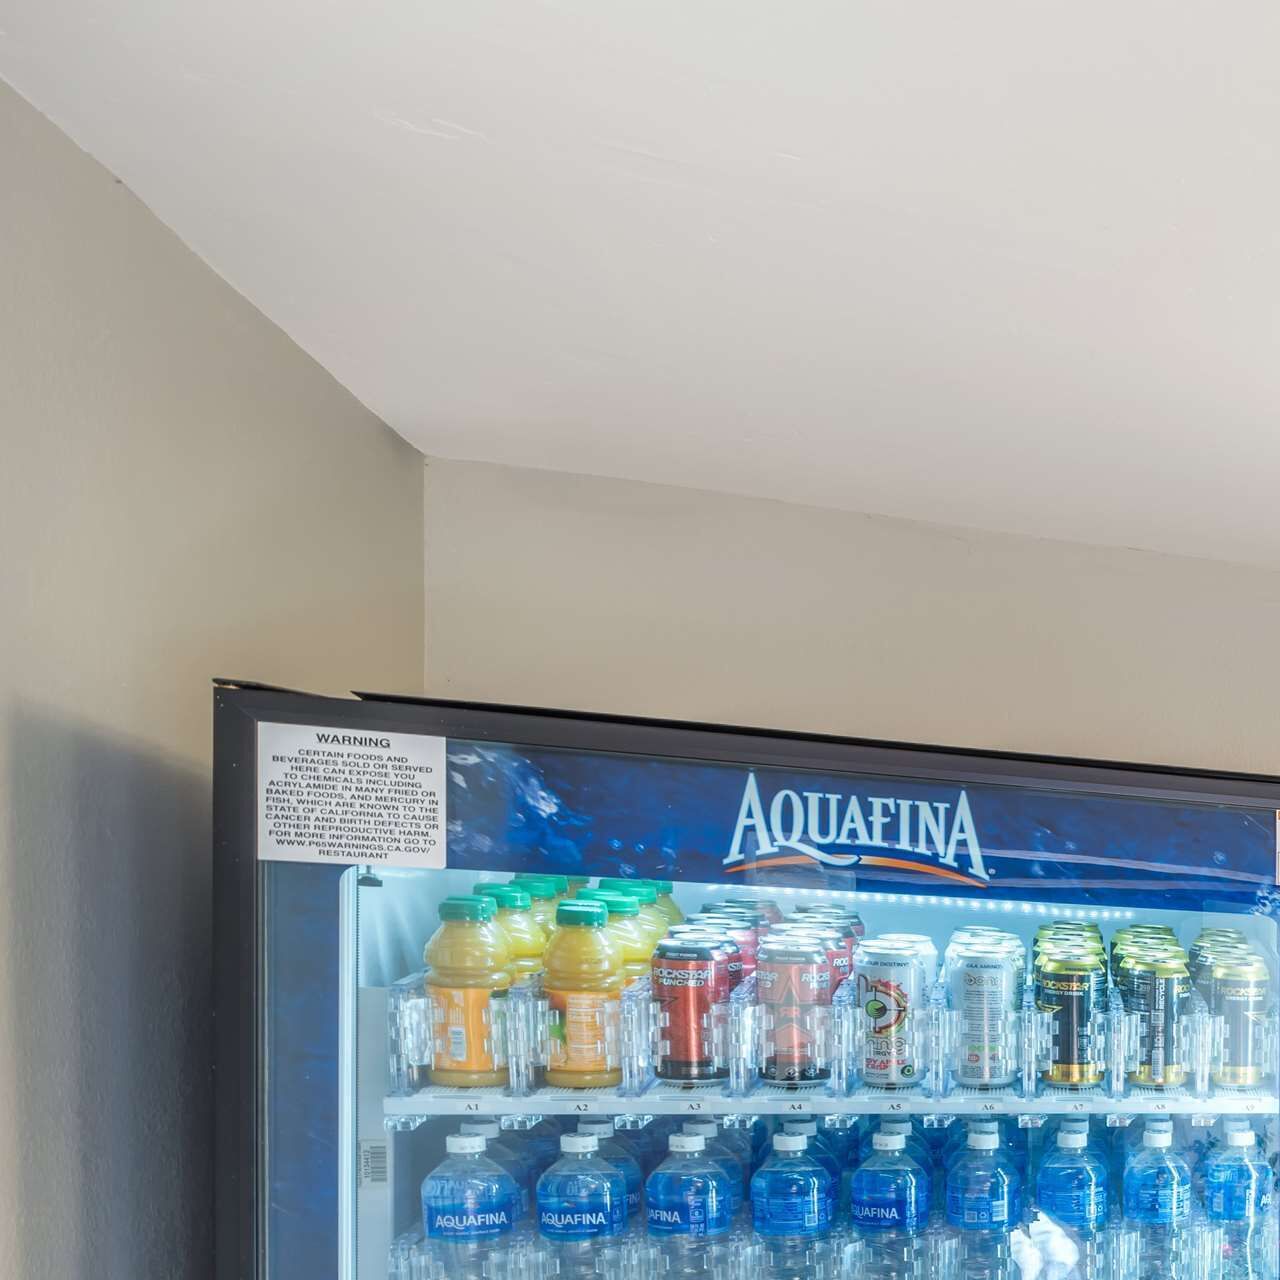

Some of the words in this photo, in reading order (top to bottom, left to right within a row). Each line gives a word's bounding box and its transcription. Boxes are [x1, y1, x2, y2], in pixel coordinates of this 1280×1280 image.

[316, 733, 391, 748] WARNING
[298, 749, 344, 759] CERTAIN
[347, 753, 384, 762] FOODS
[272, 755, 339, 766] BEVERAGES
[342, 761, 370, 769] SOLD
[391, 764, 432, 773] SERVED
[290, 765, 320, 773] HERE
[349, 769, 390, 778] EXPOSE
[301, 773, 362, 784] CHEMICALS
[366, 778, 422, 788] INCLUDING
[723, 772, 990, 880] AQUAFINA
[276, 838, 430, 854] WWW.P65WARNINGS.CA.GOV/
[319, 849, 388, 859] RESTAURANT
[465, 1103, 479, 1111] A1
[435, 1212, 508, 1228] AQUAFINA
[541, 1212, 606, 1226] AQUAFINA
